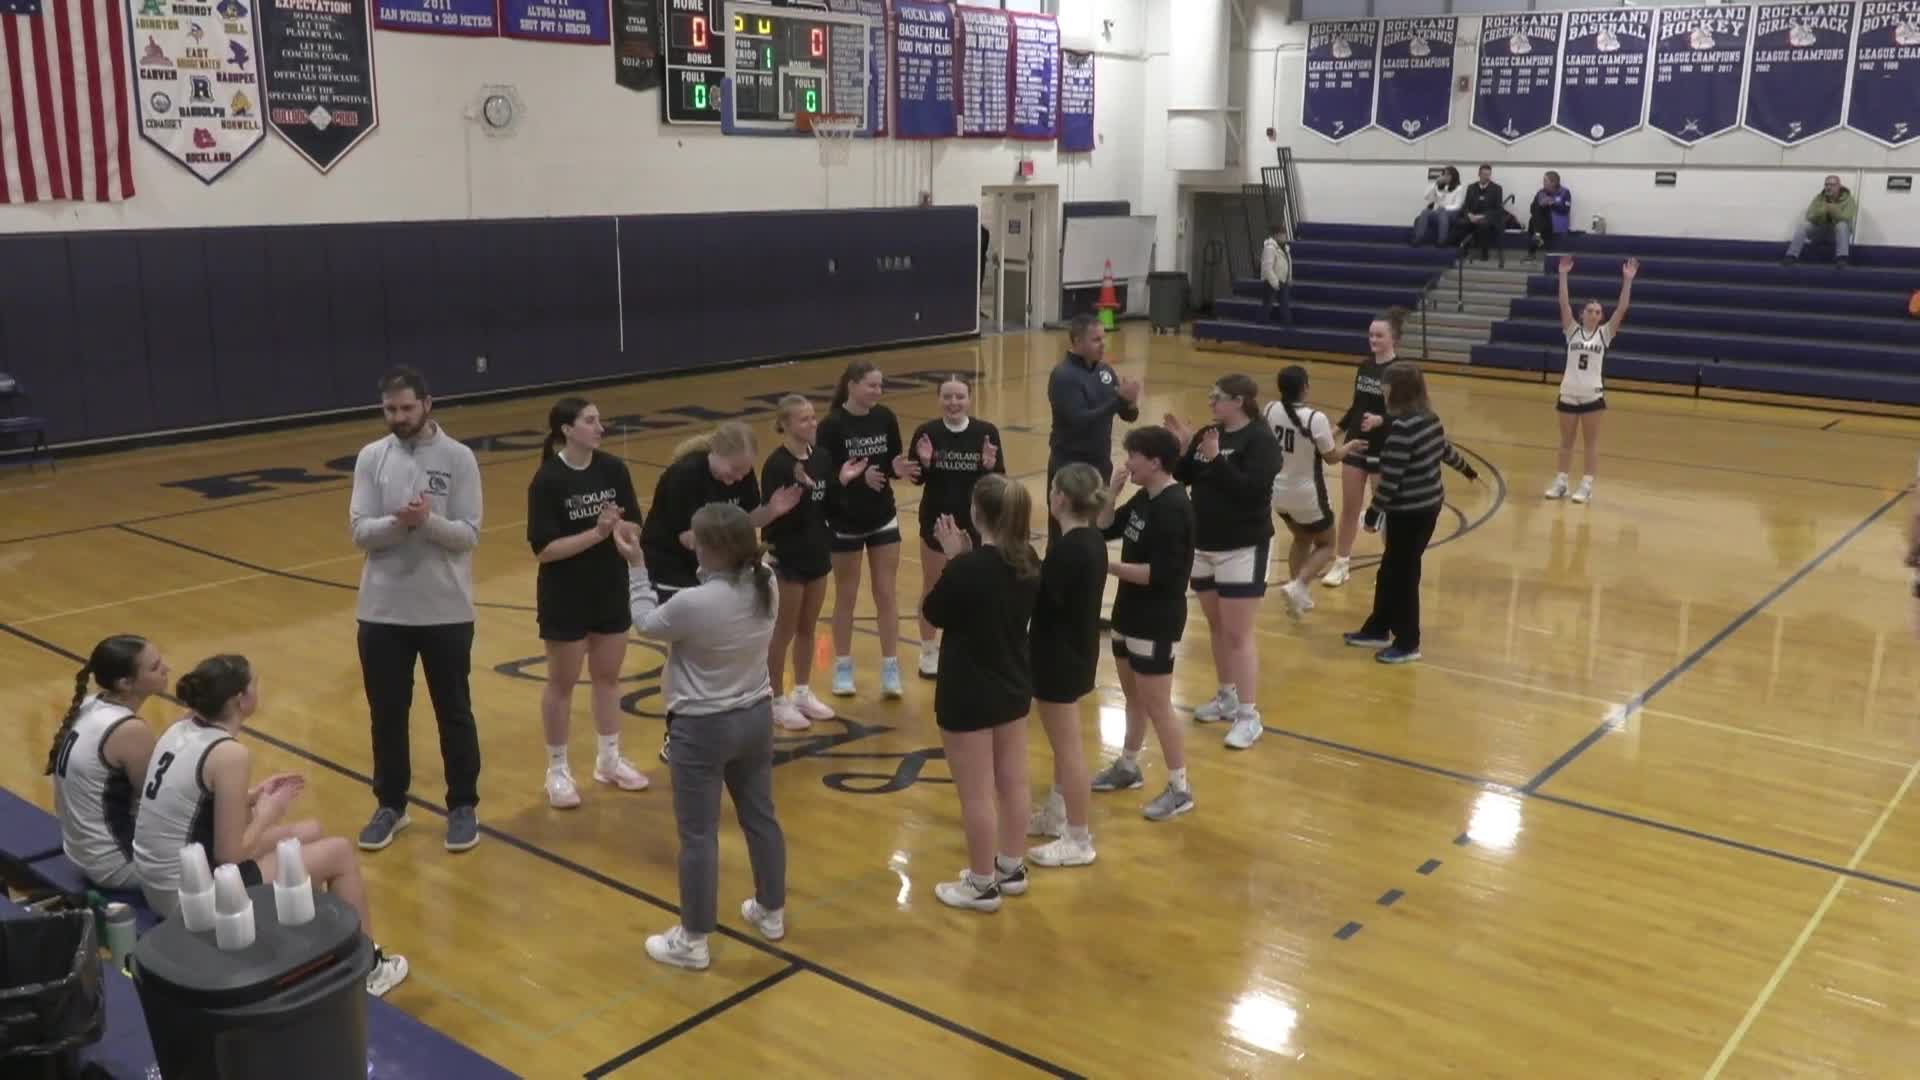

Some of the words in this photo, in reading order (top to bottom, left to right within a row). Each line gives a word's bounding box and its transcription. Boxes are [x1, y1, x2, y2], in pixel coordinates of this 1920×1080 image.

[380, 8, 397, 20] IAN
[442, 13, 458, 25] 200
[460, 15, 493, 28] METERS
[558, 8, 587, 21] JASPER
[901, 7, 946, 23] ROCKLAND
[1570, 12, 1649, 26] ROCKLAND
[1662, 7, 1746, 23] ROCKLAND
[1760, 4, 1850, 20] ROCKLAND
[297, 21, 312, 29] LET
[315, 22, 329, 30] THE
[540, 21, 555, 33] PUT
[1386, 19, 1455, 32] ROCKLAND
[1485, 15, 1559, 29] ROCKLAND
[1757, 18, 1797, 37] GIRLS
[1801, 17, 1849, 35] TRACK
[1861, 13, 1900, 34] BOYS
[286, 27, 321, 38] PLAYERS
[692, 17, 706, 48] 0
[898, 23, 951, 40] BASKETBALL
[1311, 23, 1376, 36] ROCKLAND
[1483, 27, 1557, 43] CHEERLEADING
[1568, 23, 1646, 41] BASEBALL
[1661, 20, 1744, 40] HOCKEY
[811, 28, 824, 57] 0
[1384, 30, 1414, 47] GIRLS
[1416, 28, 1454, 45] TENNIS
[282, 49, 320, 59] COACHES
[300, 42, 315, 51] LET
[317, 43, 333, 52] THE
[897, 40, 913, 53] 1000
[915, 42, 933, 56] POINT
[934, 43, 953, 57] CLUB
[1859, 48, 1896, 60] LEAGUE
[687, 53, 713, 64] BONUS
[766, 47, 772, 69] 1
[1481, 56, 1509, 67] LEAGUE
[1510, 55, 1554, 66] CHAMPIONS
[1566, 55, 1596, 66] LEAGUE
[1597, 53, 1643, 65] CHAMPIONS
[1658, 52, 1690, 64] LEAGUE
[1691, 50, 1741, 63] CHAMPIONS
[1755, 50, 1791, 62] LEAGUE
[1791, 48, 1844, 61] CHAMPIONS
[300, 63, 315, 72] LET
[317, 64, 332, 72] THE
[1308, 60, 1334, 71] LEAGUE
[1334, 59, 1372, 70] CHAMPIONS
[1383, 58, 1409, 69] LEAGUE
[1410, 57, 1450, 68] CHAMPIONS
[140, 69, 177, 80] CARVER
[274, 71, 317, 81] OFFICIALS
[681, 71, 705, 82] FOULS
[301, 84, 316, 93] LET
[319, 85, 334, 94] THE
[795, 79, 816, 89] FOULS
[268, 91, 318, 101] SPECTATORS
[695, 84, 707, 108] 0
[806, 91, 817, 112] 0
[186, 152, 231, 163] ROCKLAND
[1577, 353, 1588, 370] 5
[1274, 425, 1295, 453] 20
[145, 750, 176, 800] 3
